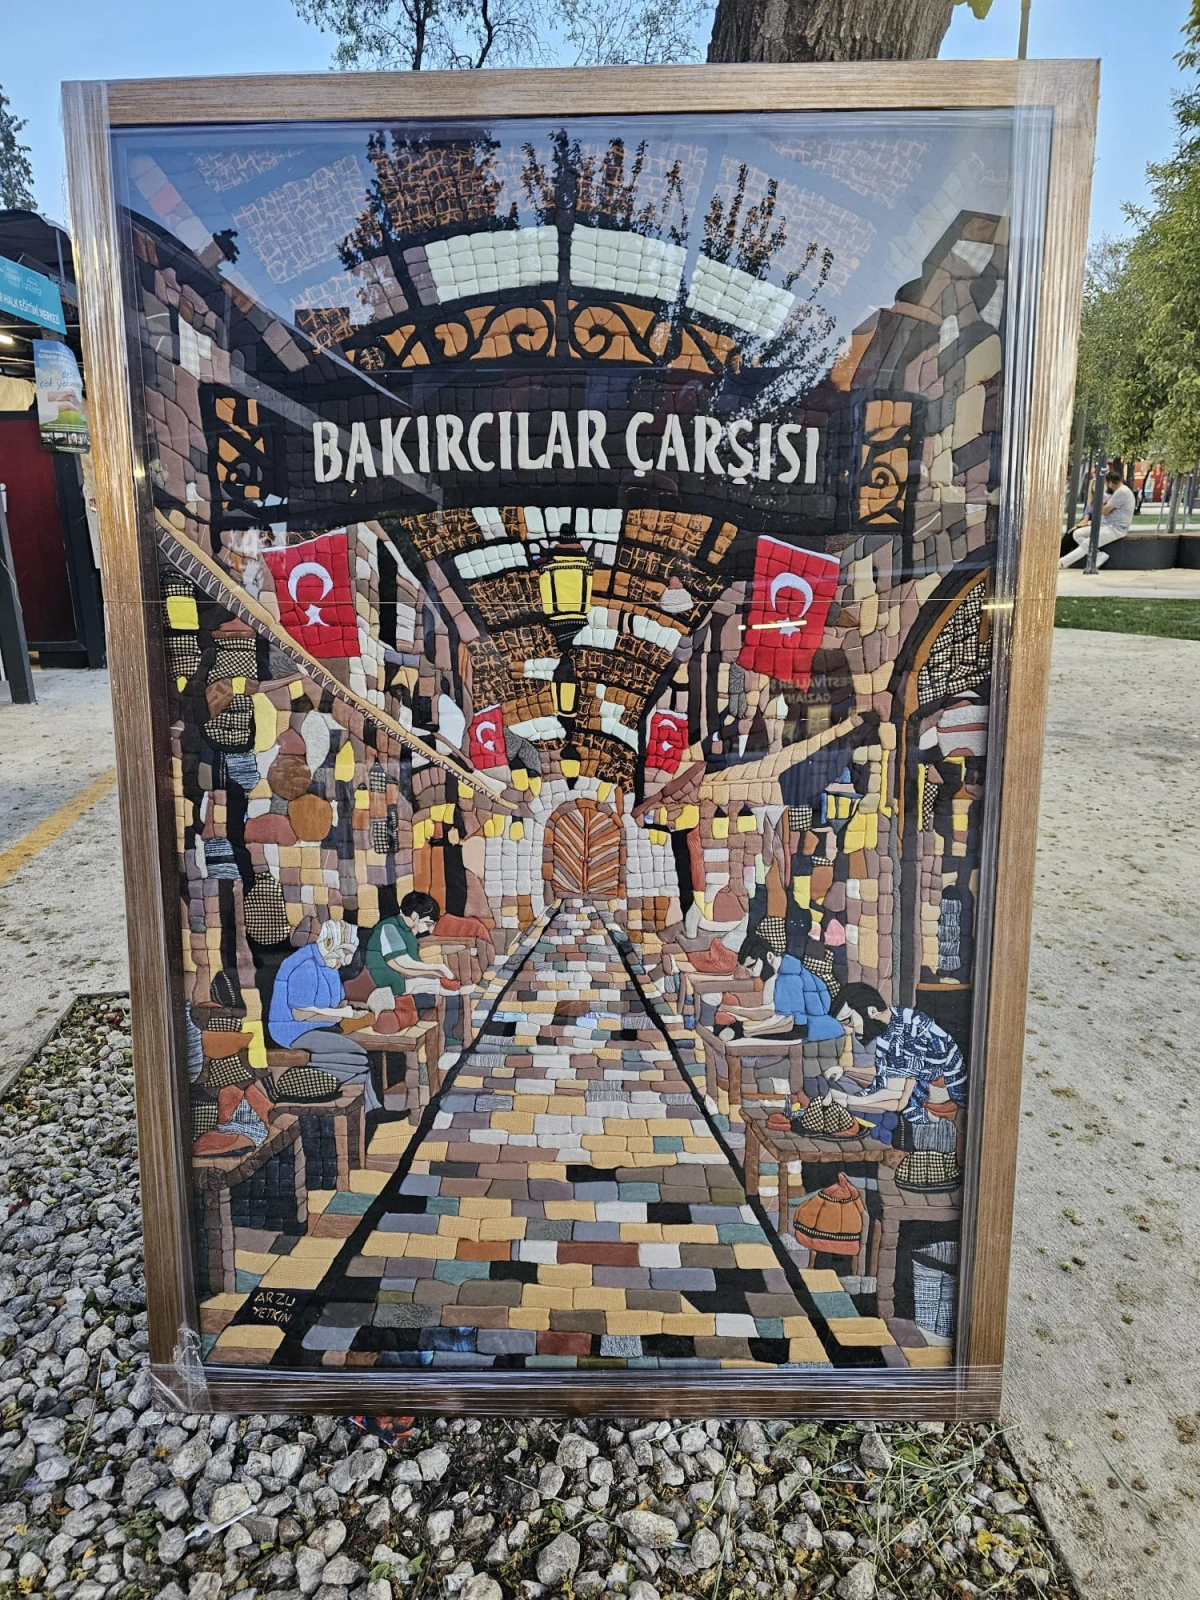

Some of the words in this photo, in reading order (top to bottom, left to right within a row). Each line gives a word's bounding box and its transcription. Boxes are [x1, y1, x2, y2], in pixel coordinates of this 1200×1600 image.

[3, 293, 20, 309] HALK
[312, 410, 610, 483] BAKIRCILAR
[625, 411, 820, 485] ÇARŞISI
[254, 1291, 296, 1307] ARZU
[252, 1306, 292, 1323] YETKİN
